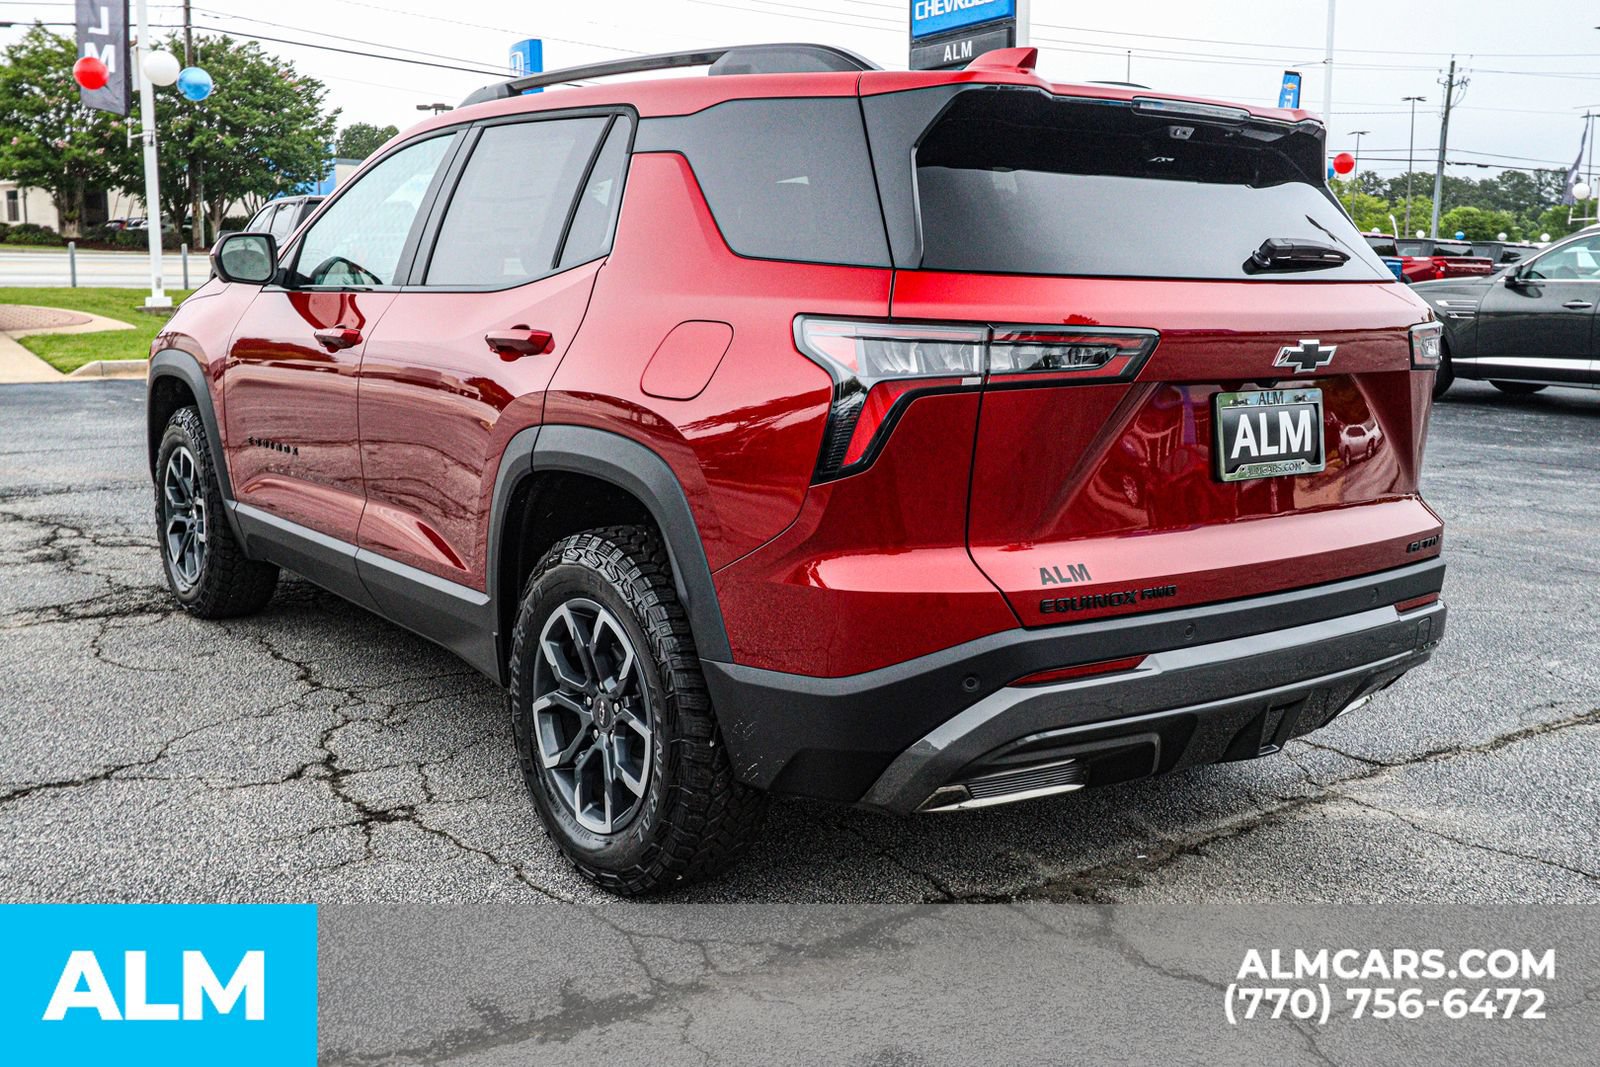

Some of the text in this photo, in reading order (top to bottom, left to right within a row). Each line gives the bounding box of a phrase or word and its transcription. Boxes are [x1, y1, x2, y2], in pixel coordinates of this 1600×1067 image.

[943, 40, 973, 62] ALM
[1258, 391, 1284, 406] ALM
[1230, 409, 1312, 459] ALM
[1039, 563, 1092, 586] ALM
[1040, 585, 1177, 614] EQUINOX AWD
